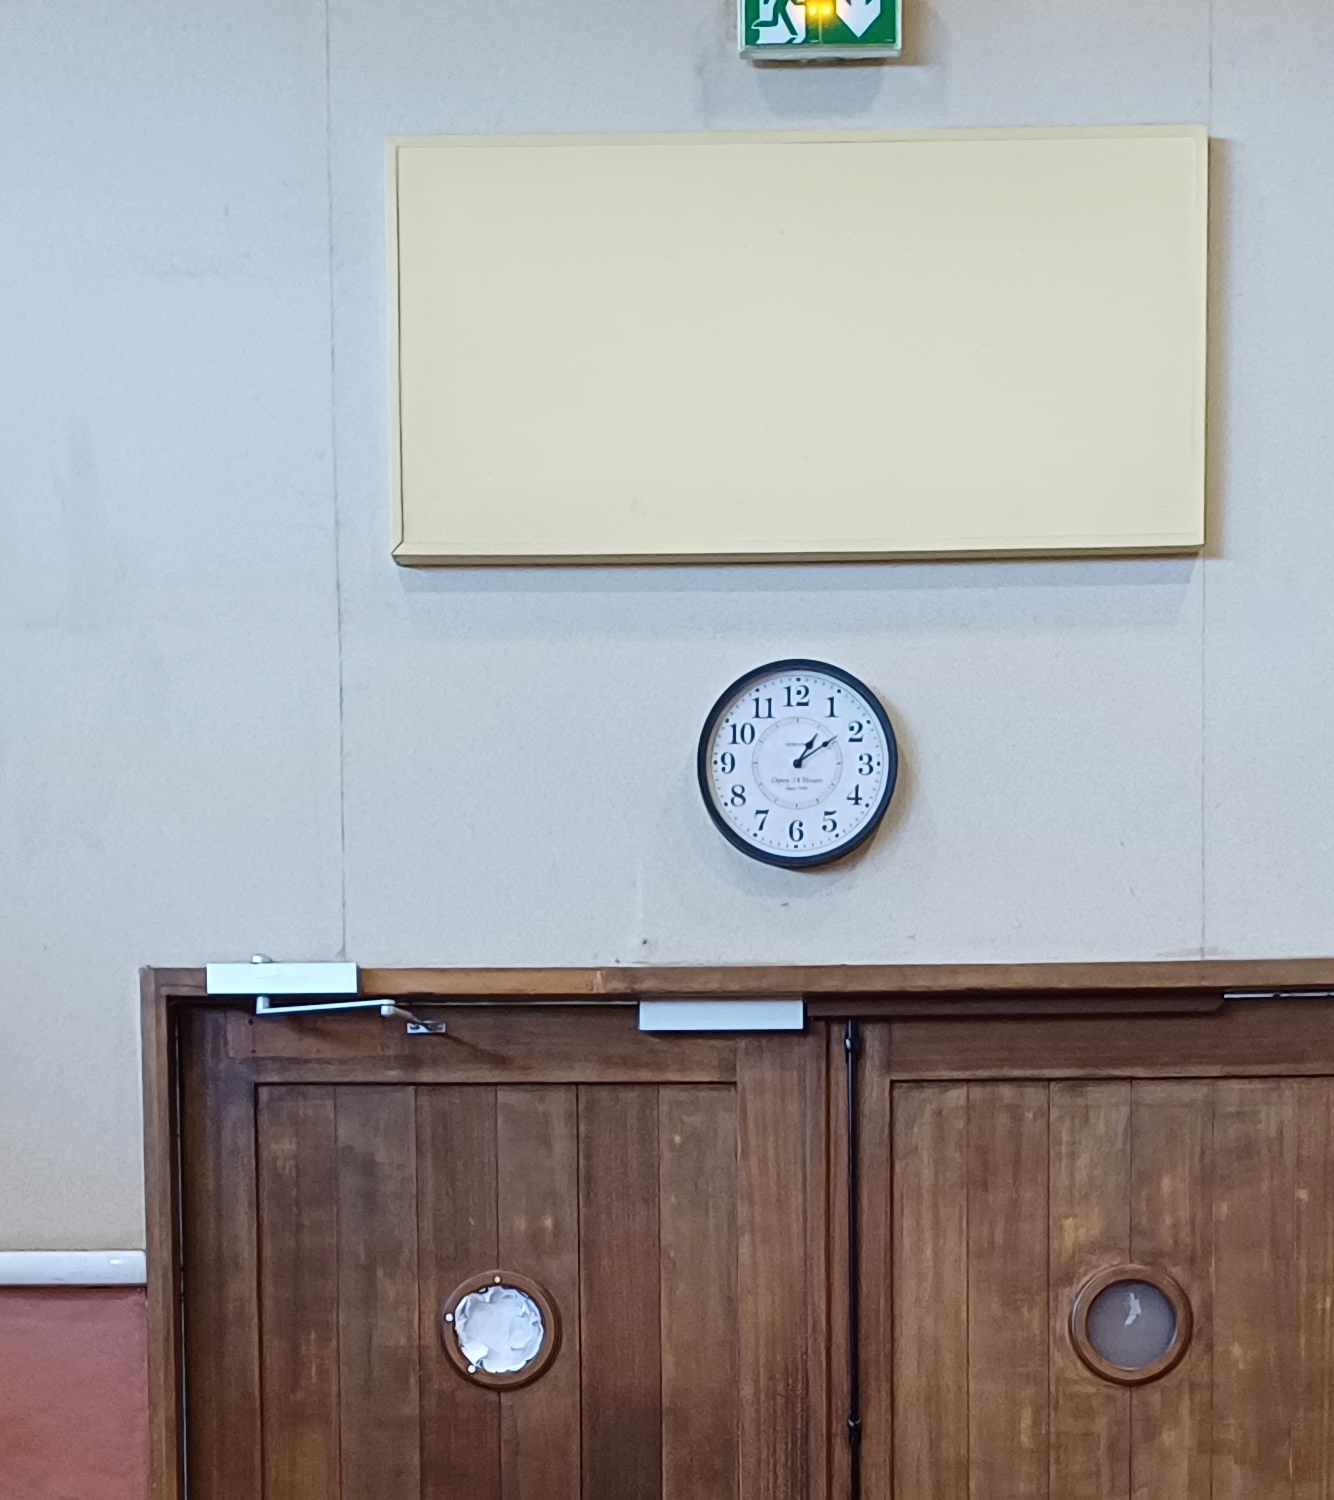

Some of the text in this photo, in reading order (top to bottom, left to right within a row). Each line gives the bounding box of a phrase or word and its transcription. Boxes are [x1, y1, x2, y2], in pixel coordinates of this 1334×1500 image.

[783, 685, 810, 707] 12
[826, 697, 838, 717] 1
[752, 697, 775, 719] 11
[728, 722, 755, 745] 10
[848, 721, 863, 742] 2
[720, 752, 735, 774] 9
[858, 753, 873, 775] 3
[730, 784, 746, 807] 8
[846, 784, 863, 806] 4
[754, 809, 769, 831] 7
[789, 820, 803, 842] 6
[822, 811, 837, 832] 5
